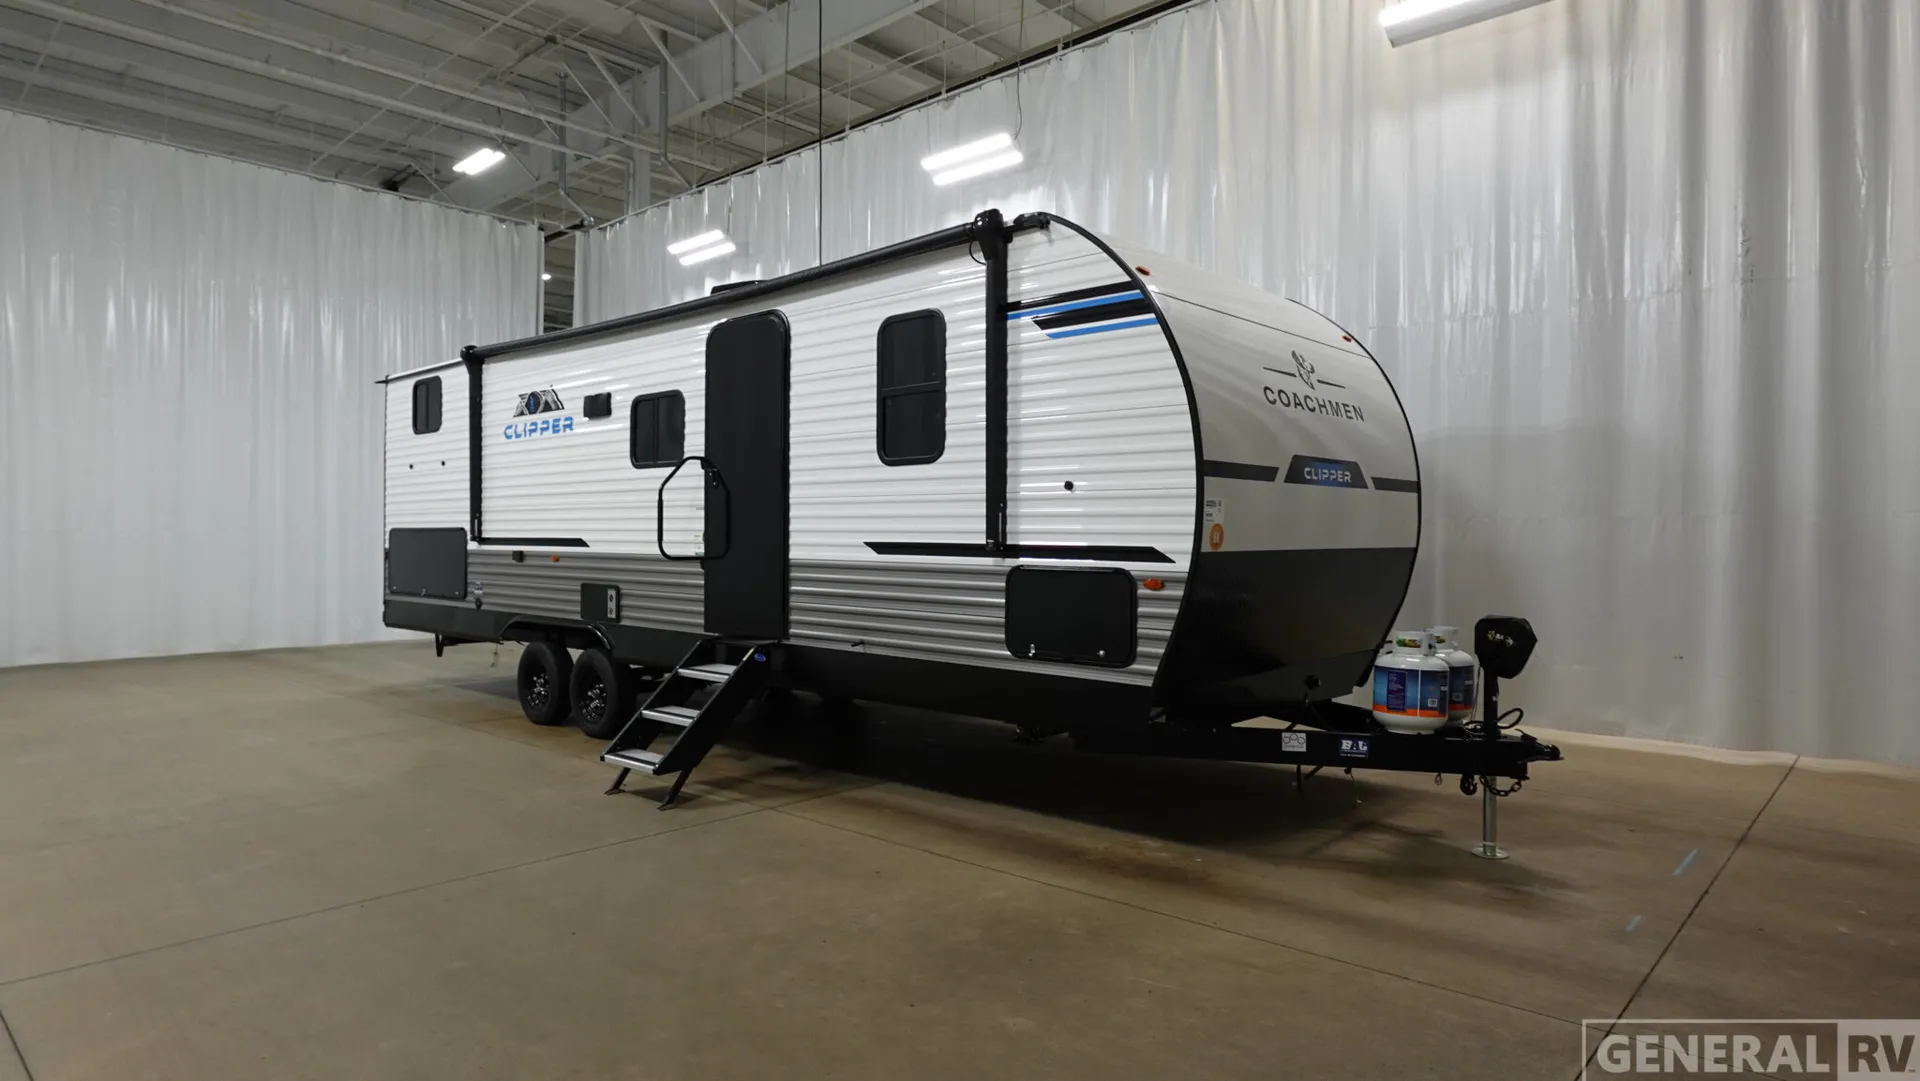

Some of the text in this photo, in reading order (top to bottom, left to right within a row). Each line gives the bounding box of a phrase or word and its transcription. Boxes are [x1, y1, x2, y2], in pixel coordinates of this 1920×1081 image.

[1263, 385, 1365, 422] COACHMEN
[503, 416, 574, 440] CLIPPER
[1303, 467, 1352, 482] CLIPPER
